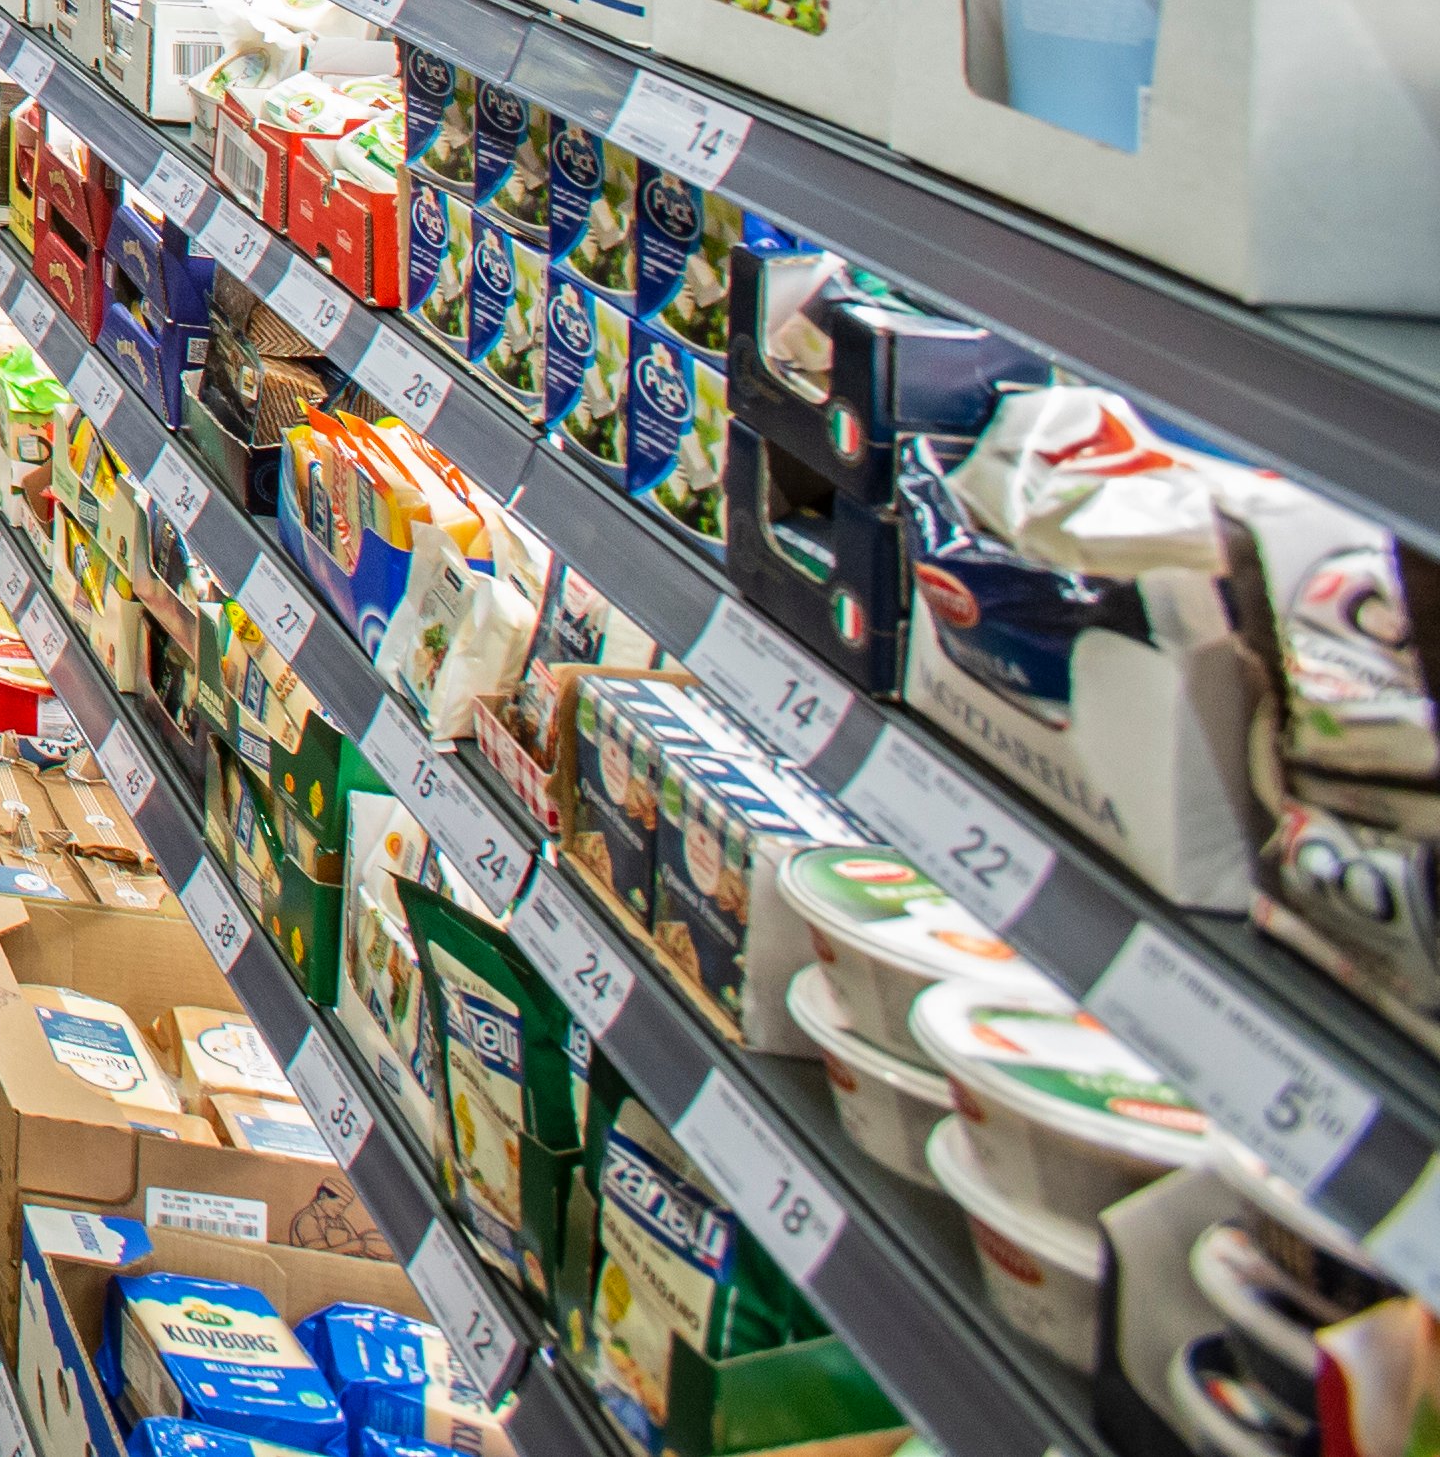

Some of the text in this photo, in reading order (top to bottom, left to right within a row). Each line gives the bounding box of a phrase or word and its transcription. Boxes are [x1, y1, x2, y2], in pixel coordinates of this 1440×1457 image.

[562, 142, 597, 174] Puck
[688, 121, 724, 161] 14
[417, 205, 448, 237] Puck
[652, 191, 696, 225] Puck
[482, 249, 512, 283] Puck
[312, 299, 340, 330] 19
[557, 305, 593, 343] Puck
[402, 373, 433, 408] 26
[643, 367, 689, 411] Puck
[274, 602, 302, 636] 27
[778, 679, 816, 727] 14
[410, 767, 438, 800] 15
[475, 844, 508, 883] 24
[951, 824, 1011, 887] 22
[213, 918, 241, 953] 38
[575, 953, 610, 999] 24
[329, 1097, 359, 1140] 35
[1265, 1083, 1303, 1137] 5
[769, 1175, 811, 1235] 18
[189, 1310, 229, 1326] Arla
